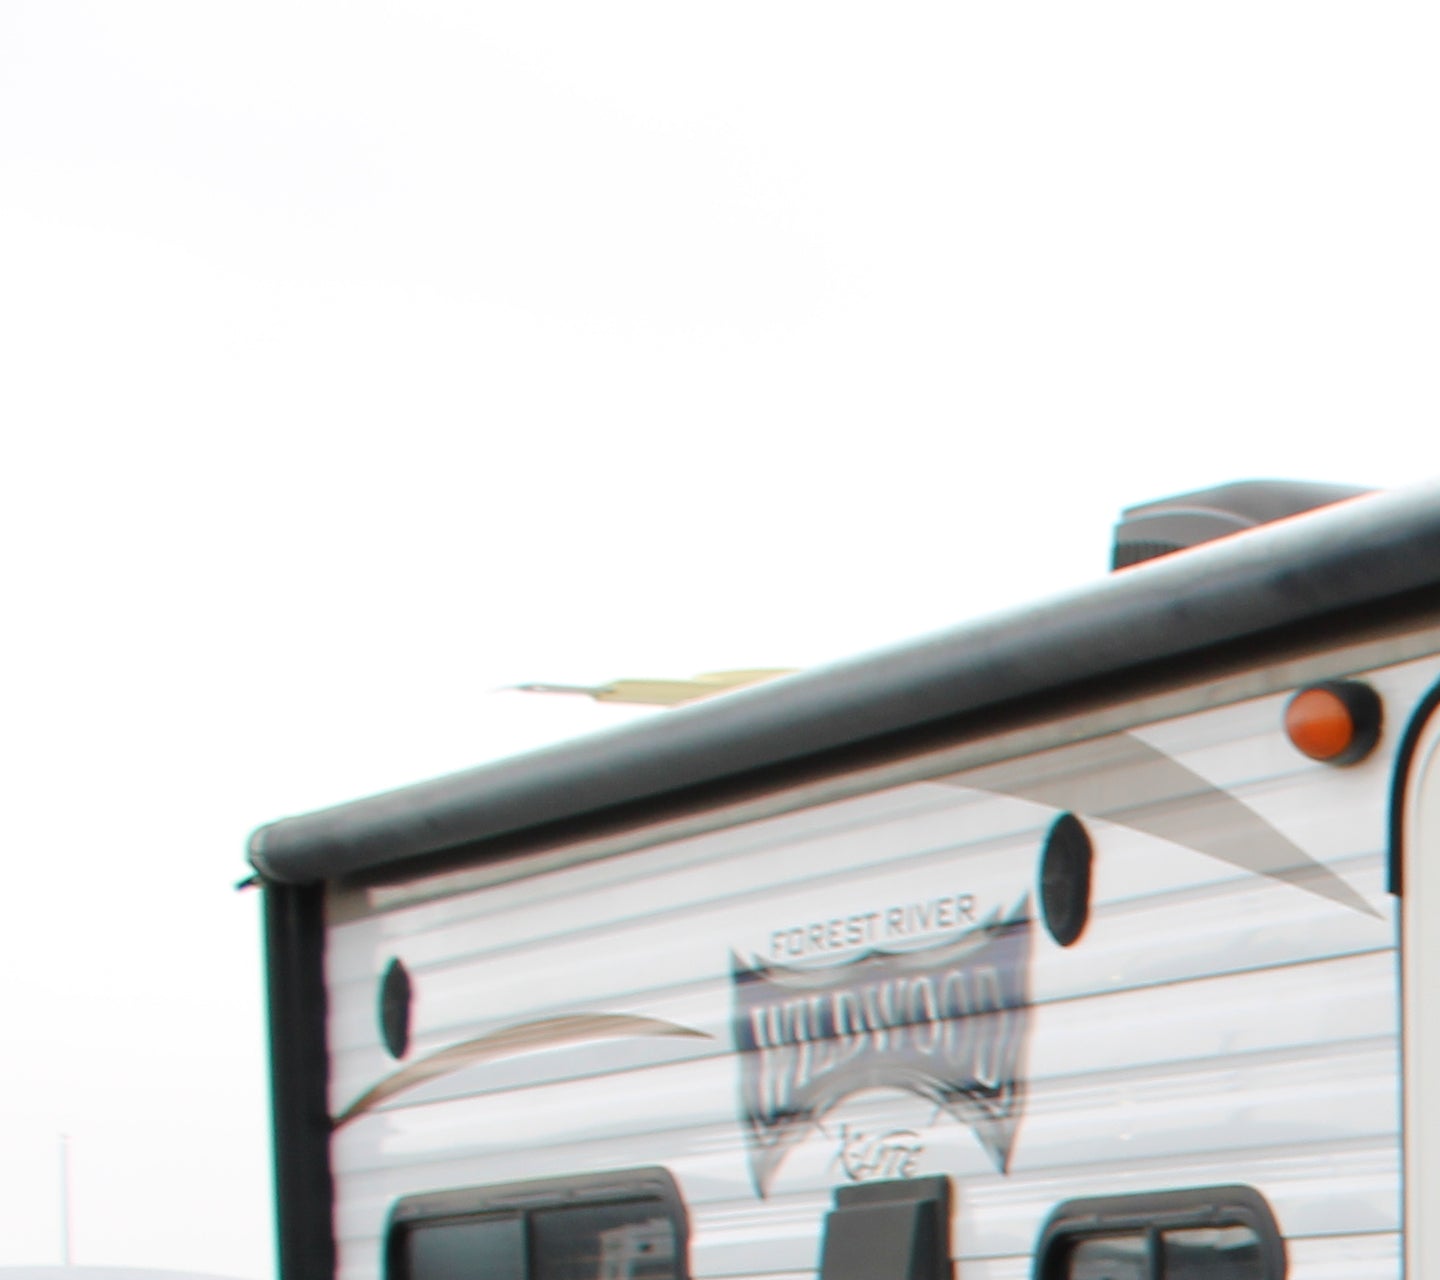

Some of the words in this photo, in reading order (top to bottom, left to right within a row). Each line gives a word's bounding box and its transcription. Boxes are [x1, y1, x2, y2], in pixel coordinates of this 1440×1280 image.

[770, 911, 880, 958] FOREST
[885, 893, 976, 935] RIVER
[752, 964, 1000, 1119] WILDWOOD
